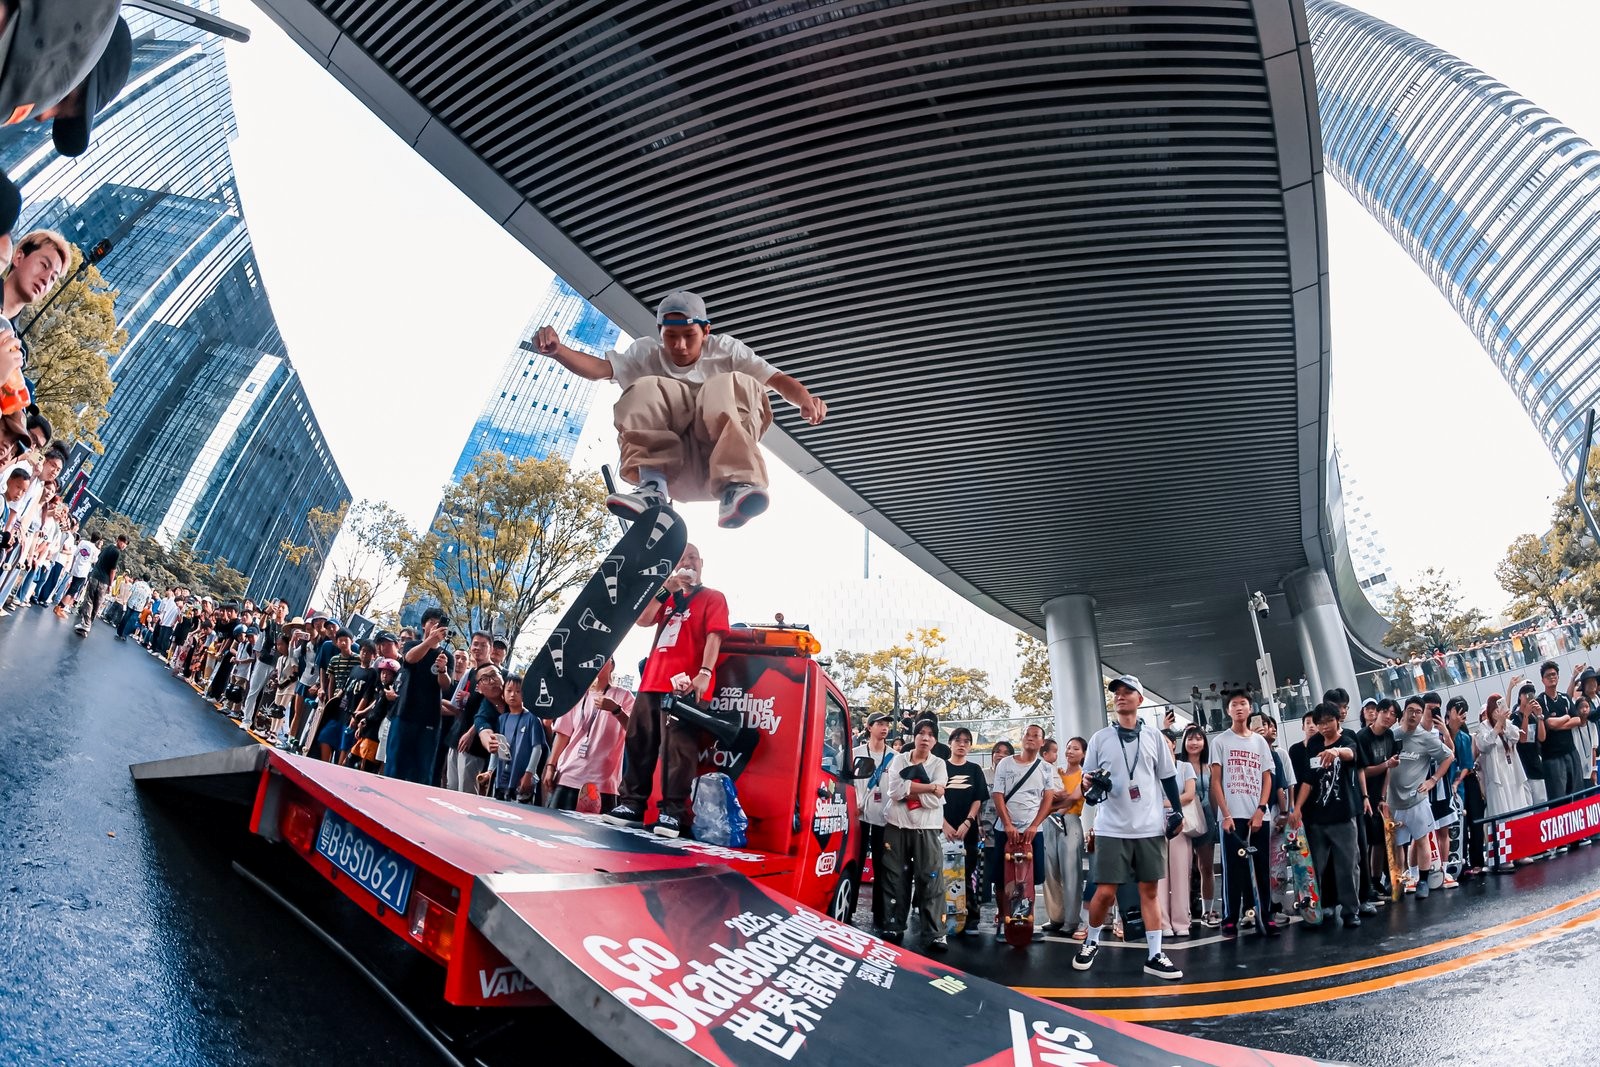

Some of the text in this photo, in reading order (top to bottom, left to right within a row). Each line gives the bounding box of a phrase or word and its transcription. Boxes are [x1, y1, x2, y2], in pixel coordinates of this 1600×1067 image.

[709, 693, 776, 714] oarding
[720, 687, 743, 697] 2025
[748, 711, 782, 735] Day
[1228, 759, 1247, 767] STREET
[1540, 802, 1600, 843] STARTING NO
[724, 911, 772, 938] 2025
[583, 935, 681, 981] Go
[612, 905, 822, 1043] Skateboarding
[722, 943, 857, 1061] 世界滑板日
